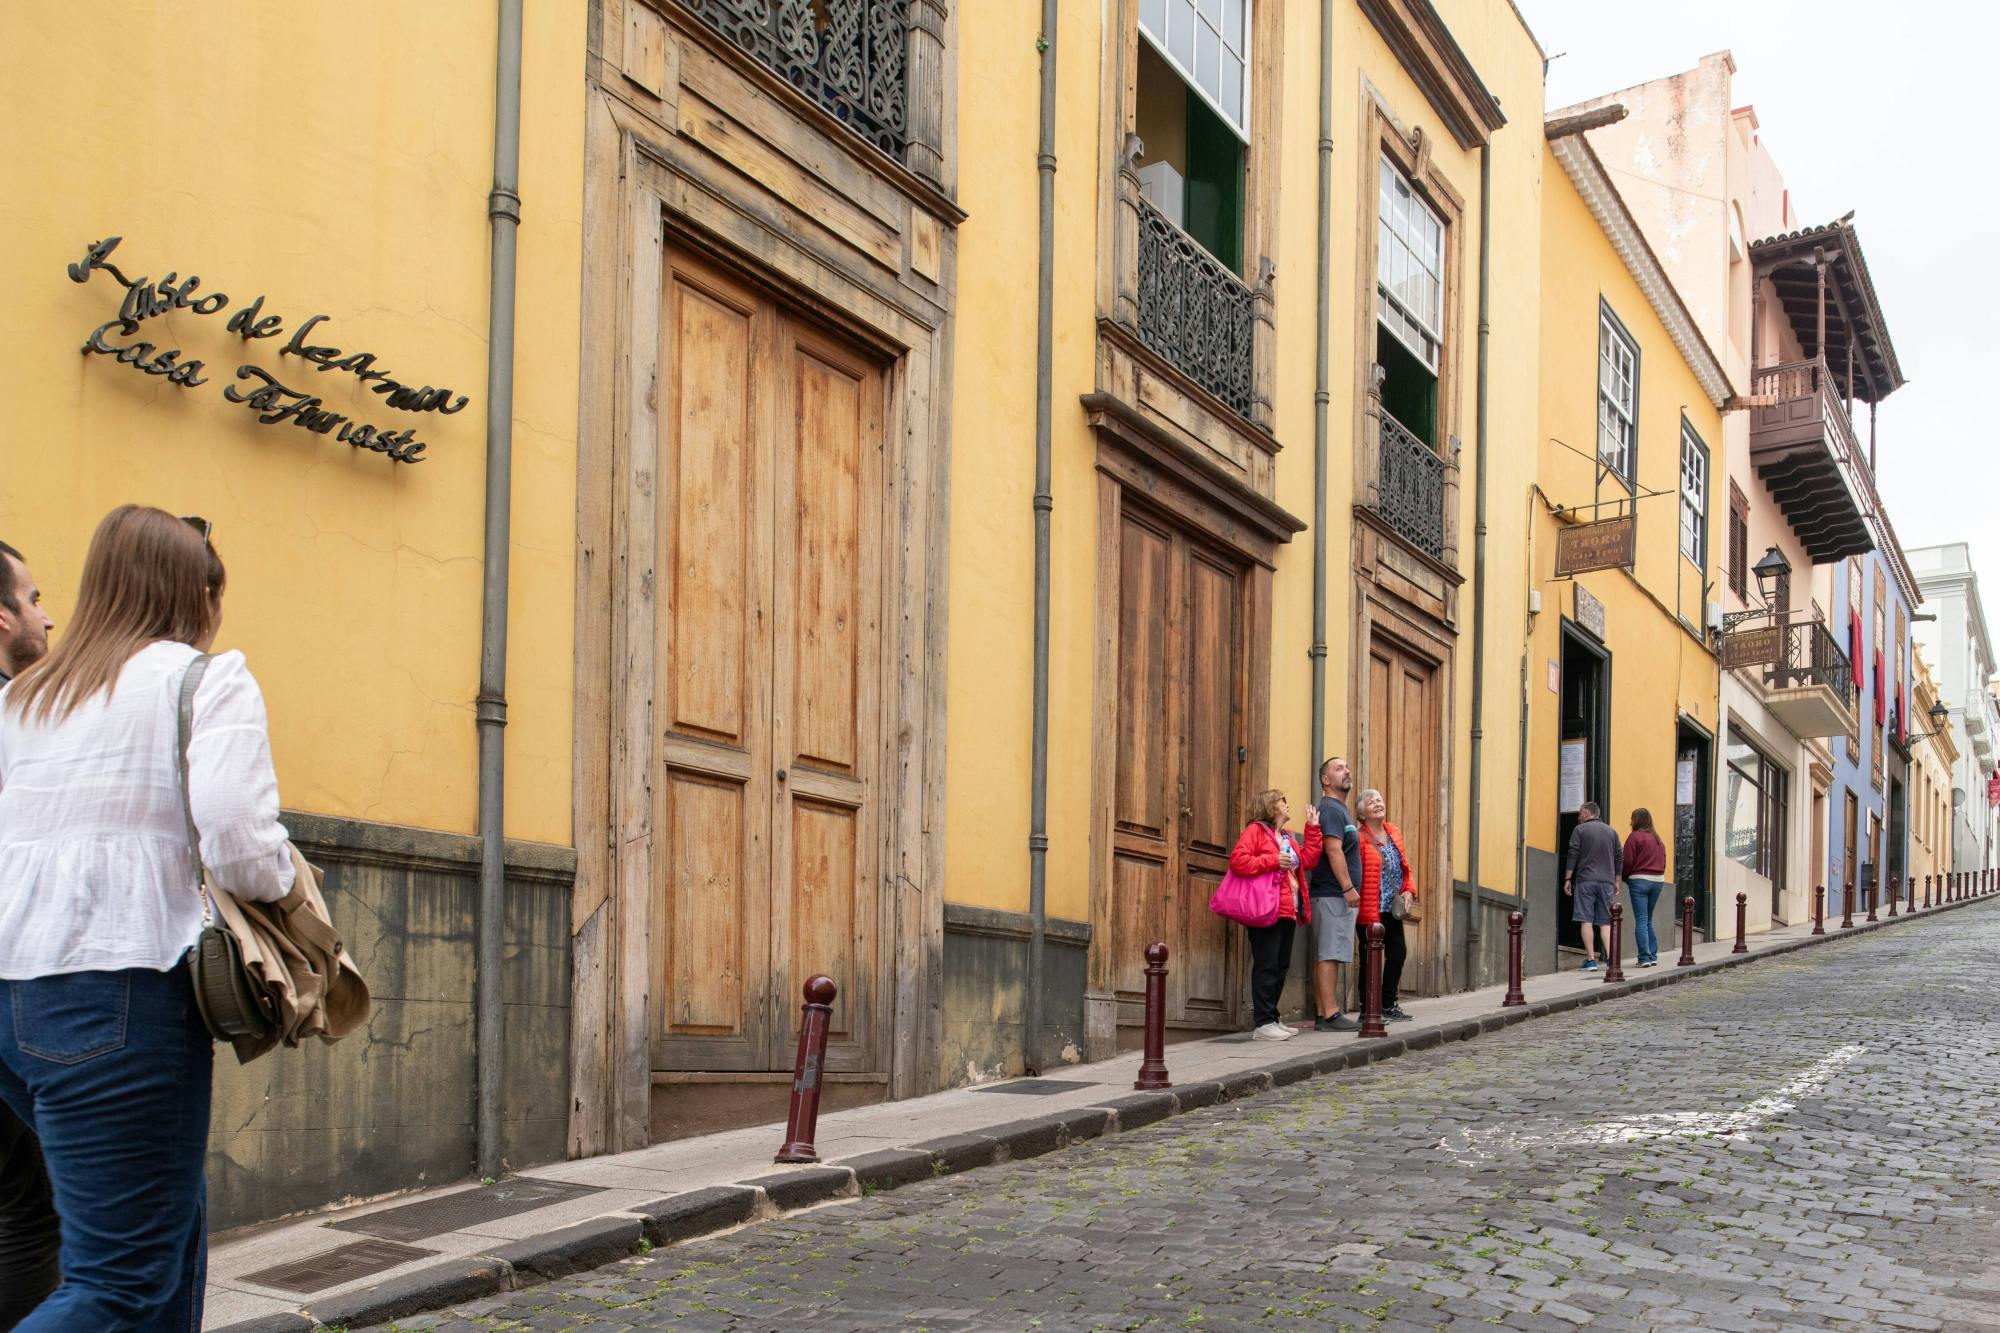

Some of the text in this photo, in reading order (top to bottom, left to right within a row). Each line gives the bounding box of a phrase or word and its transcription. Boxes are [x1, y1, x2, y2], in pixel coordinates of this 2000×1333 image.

[68, 236, 230, 321] Museo
[227, 295, 283, 340] de
[88, 319, 209, 388] Casa
[1570, 533, 1621, 549] TAORO
[1732, 638, 1770, 650] TAORO
